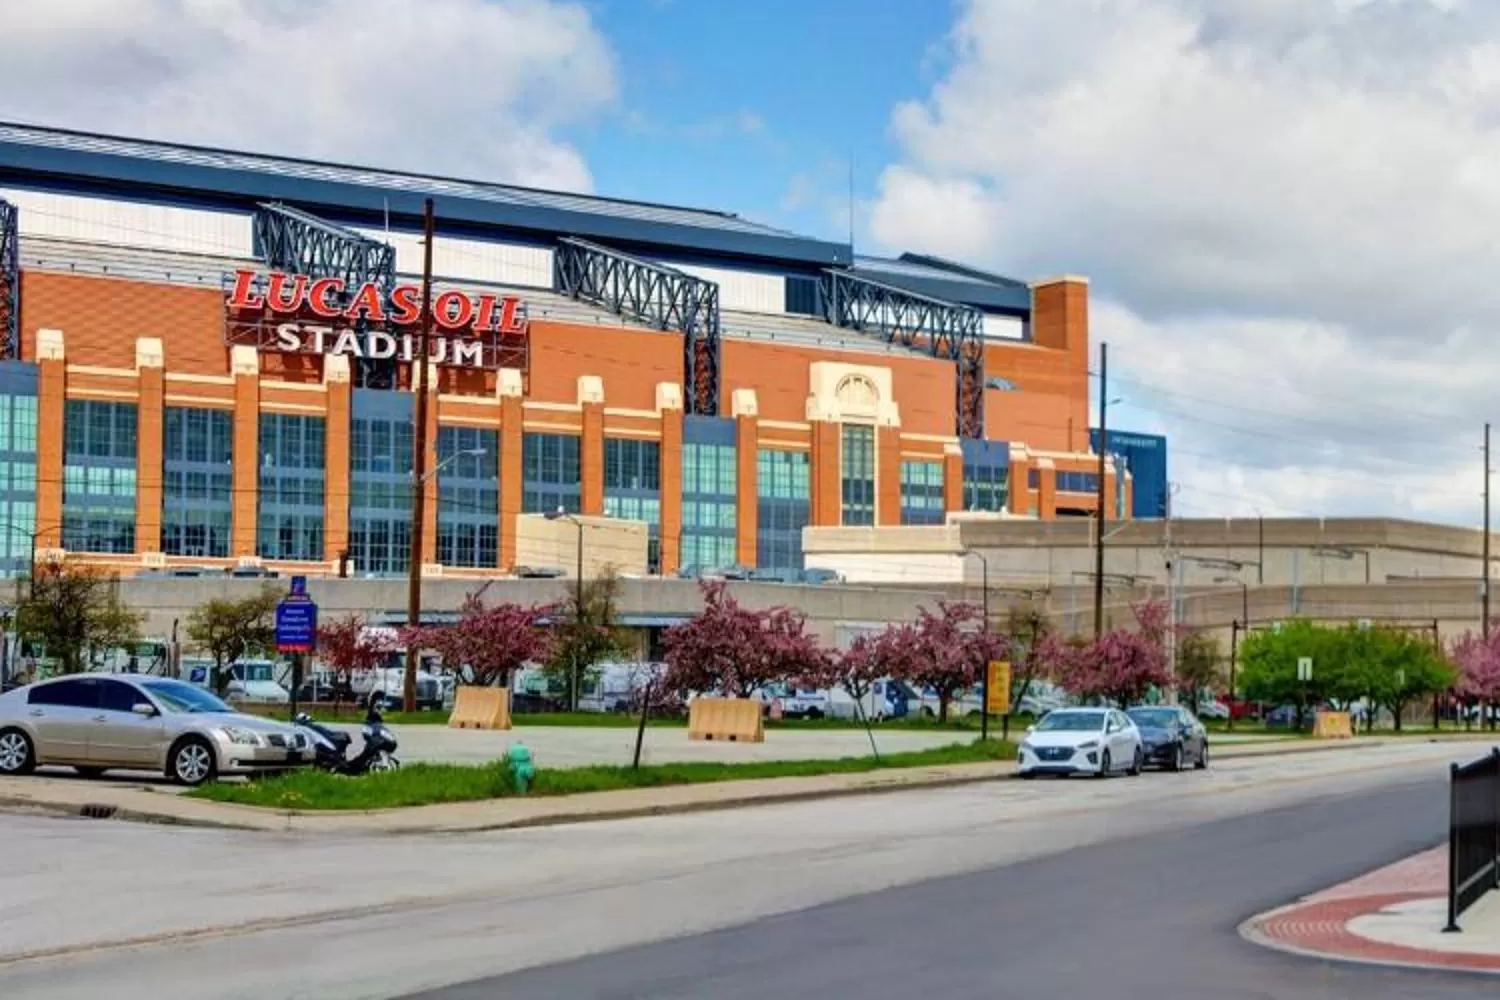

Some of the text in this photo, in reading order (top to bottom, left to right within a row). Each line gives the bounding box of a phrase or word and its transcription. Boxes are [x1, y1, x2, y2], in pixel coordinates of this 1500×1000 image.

[227, 269, 528, 334] LUCAS OIL
[276, 322, 484, 367] STADIUM
